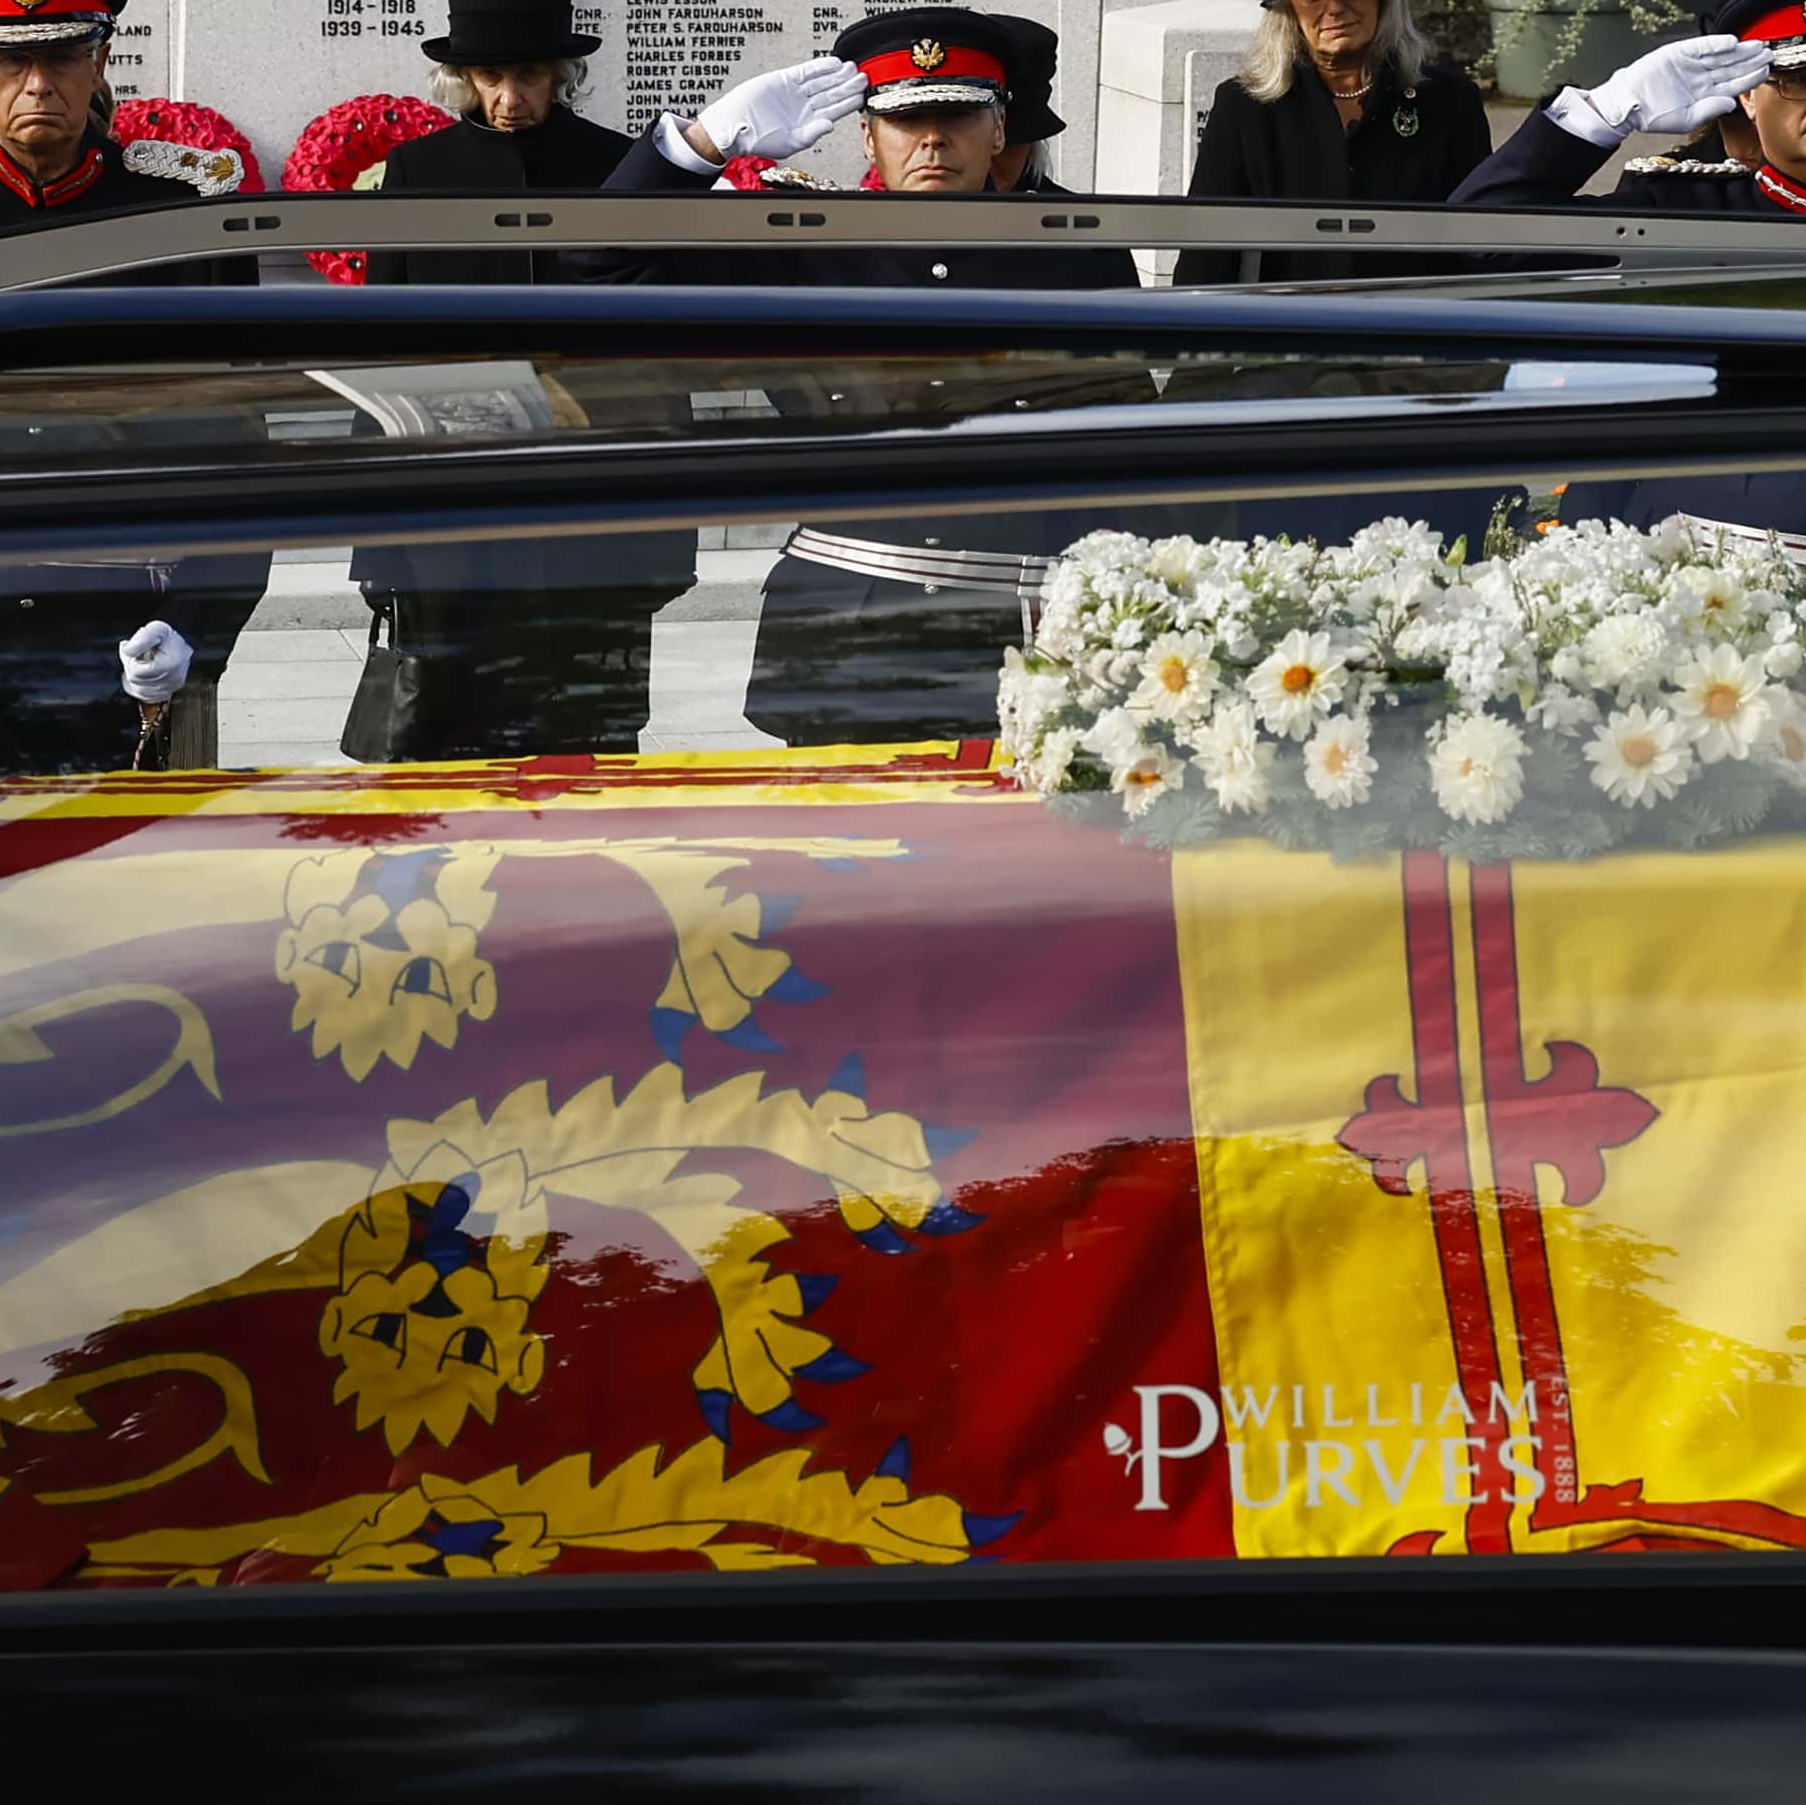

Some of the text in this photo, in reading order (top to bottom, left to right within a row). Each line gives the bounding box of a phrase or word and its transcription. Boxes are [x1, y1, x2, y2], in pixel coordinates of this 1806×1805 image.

[627, 9, 661, 19] JOHN
[322, 21, 424, 36] 1939 1945
[627, 23, 666, 33] PETER
[627, 37, 744, 47] WILLIAM FERRIER
[627, 51, 740, 62] CHARLES FORBES
[627, 65, 729, 76] ROBERT GIBSON
[627, 80, 723, 90] JAMES GRANT
[627, 94, 705, 105] JOHN MARR
[1220, 1381, 1540, 1429] WILLIAM
[1133, 1384, 1547, 1511] PURVES
[1554, 1444, 1575, 1504] 1888
